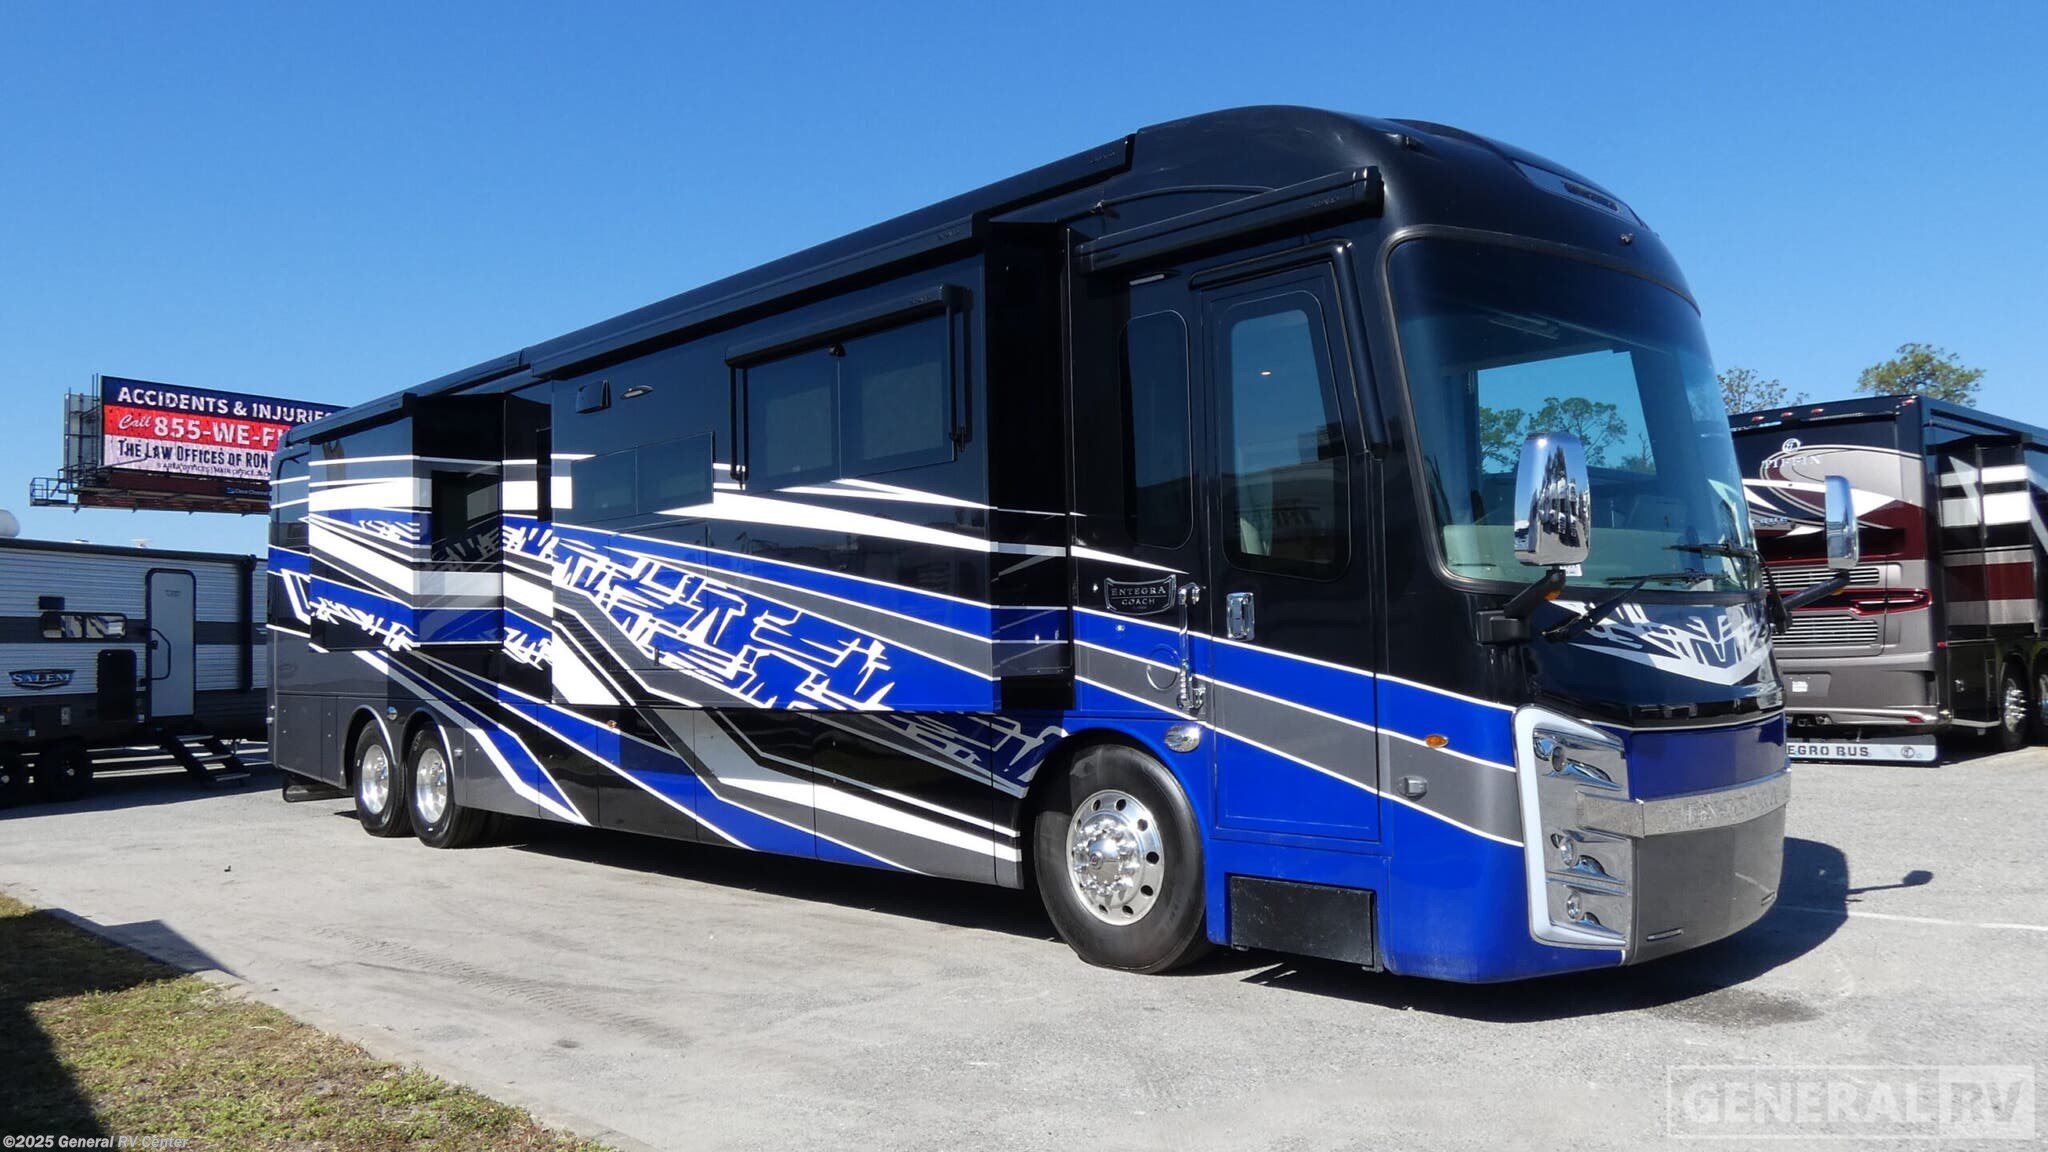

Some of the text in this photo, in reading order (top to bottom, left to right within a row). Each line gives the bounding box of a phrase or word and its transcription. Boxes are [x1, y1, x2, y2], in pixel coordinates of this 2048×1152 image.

[117, 387, 229, 414] ACCIDENTS
[232, 401, 248, 416] &
[118, 414, 152, 430] Call
[117, 439, 269, 470] THE LAW OFFICES OF RON
[1111, 586, 1166, 596] ENTEGRA
[1121, 598, 1155, 606] COACH
[12, 673, 70, 682] SALEM
[1836, 746, 1869, 757] BUS
